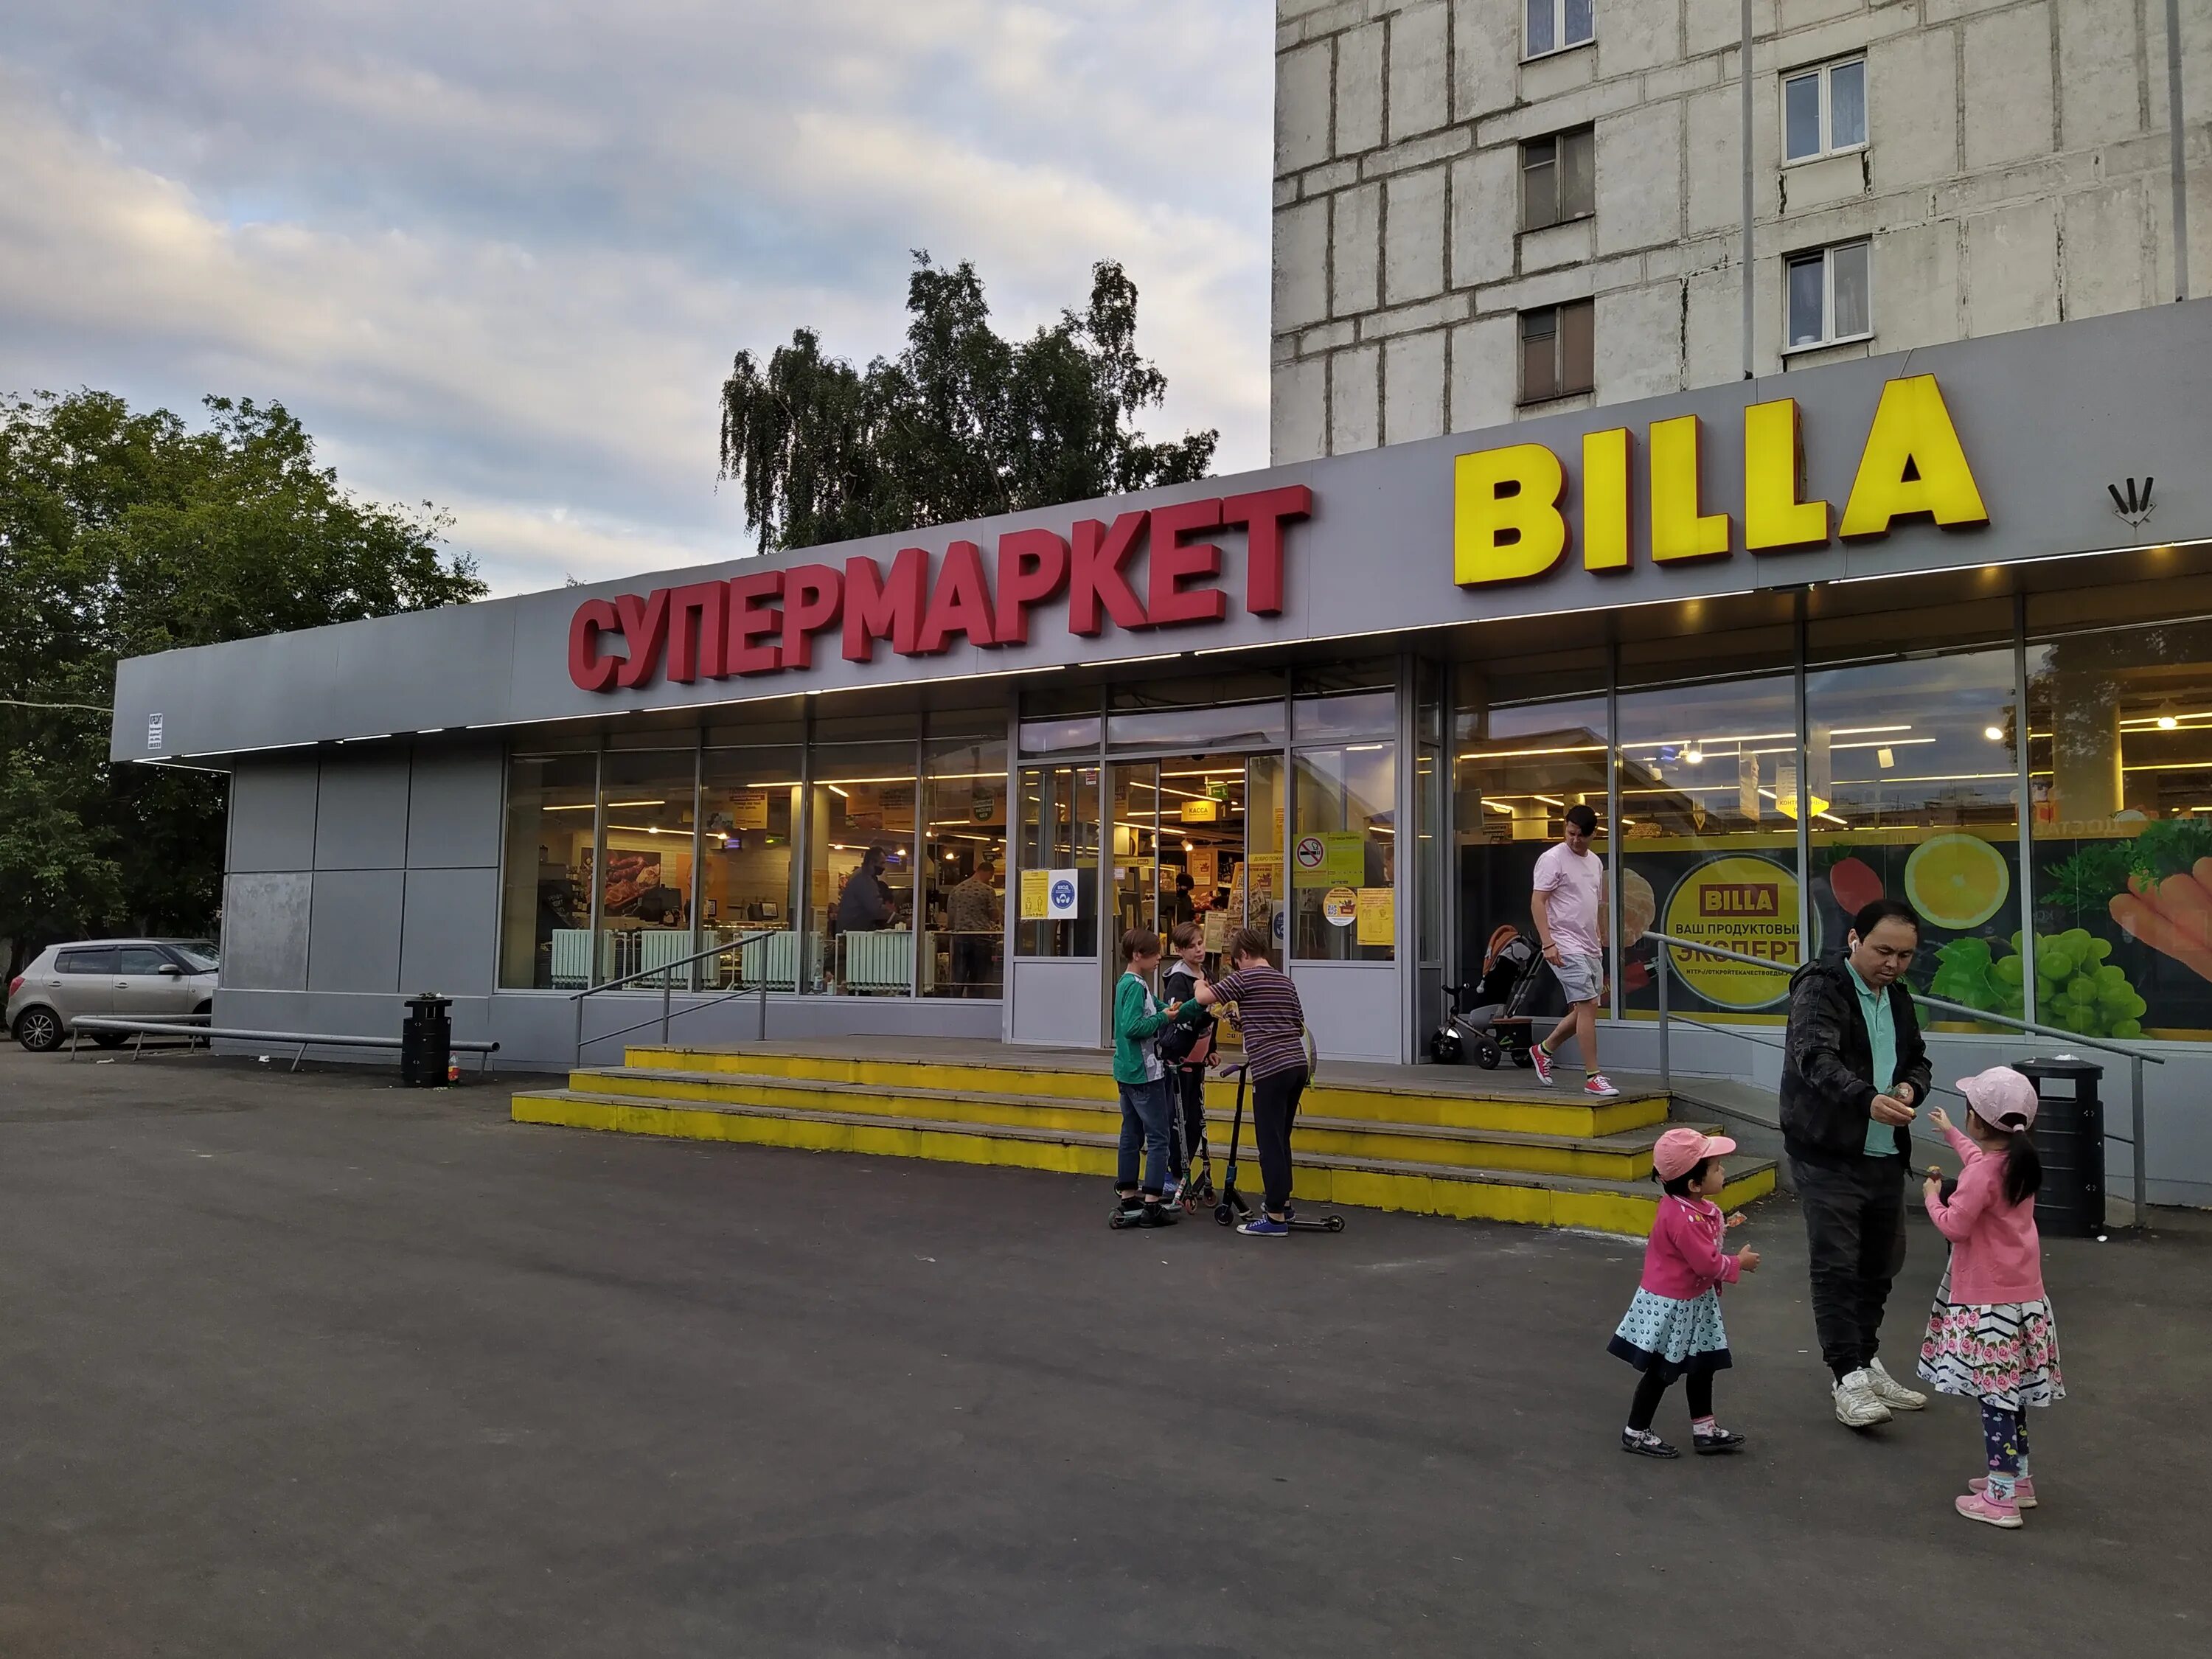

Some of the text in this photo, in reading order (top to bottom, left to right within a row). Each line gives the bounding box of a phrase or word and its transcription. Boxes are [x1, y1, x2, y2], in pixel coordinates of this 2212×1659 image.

[1453, 373, 1990, 588] BILLA
[567, 484, 1312, 693] СУПЕРМАРКЕТ
[150, 714, 161, 724] КРЕДИТ
[1705, 890, 1773, 911] BILLA
[1676, 924, 1705, 934] ВАШ
[1676, 939, 1801, 964] ЭКСПЕРТ
